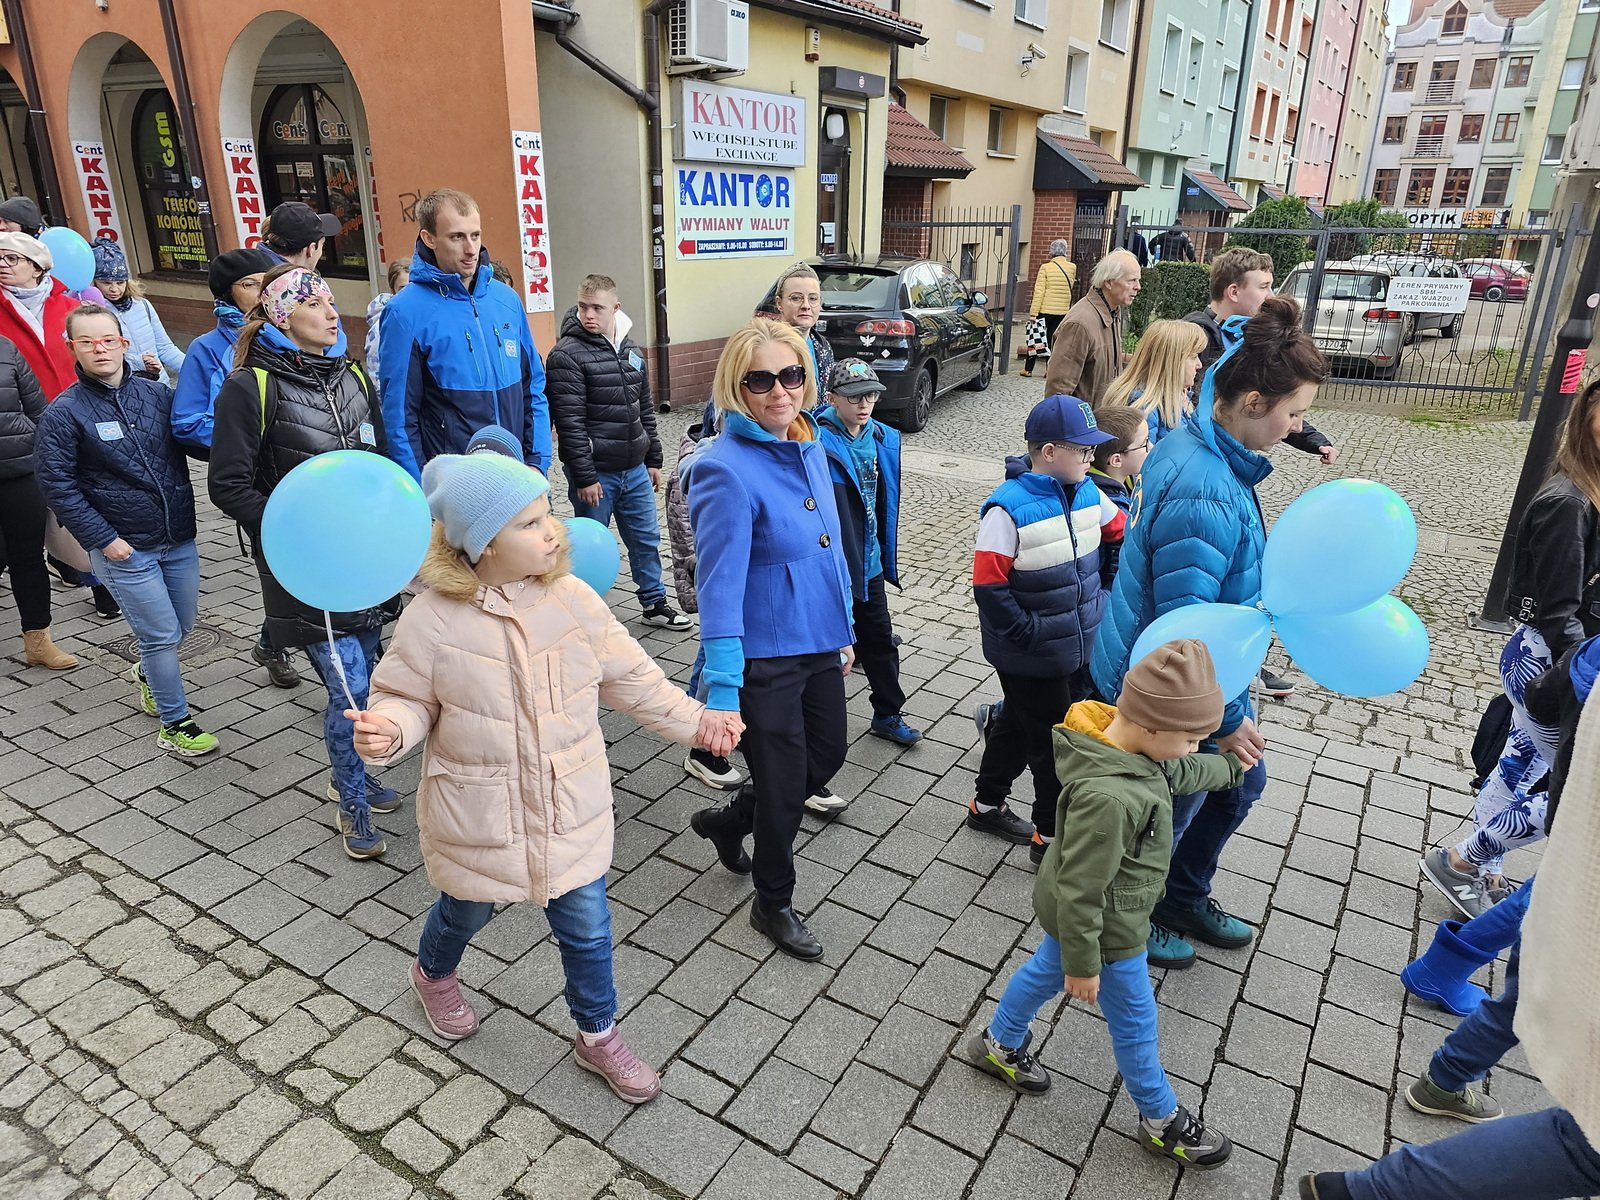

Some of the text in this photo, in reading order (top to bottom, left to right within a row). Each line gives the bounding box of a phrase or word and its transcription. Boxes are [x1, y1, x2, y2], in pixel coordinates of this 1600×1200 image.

[690, 90, 797, 135] KANTOR
[273, 120, 305, 138] Cent
[224, 141, 253, 153] Cent
[514, 137, 541, 149] Cent
[692, 130, 798, 150] WECHSELSTUBE
[75, 145, 103, 155] Cent
[716, 147, 778, 162] EXCHANGE
[678, 169, 790, 208] KANTOR
[80, 157, 119, 242] KANTO
[163, 197, 197, 213] TELEFO
[230, 156, 263, 249] KANTO
[156, 214, 202, 230] KOMÓRK
[519, 154, 549, 294] KANTOR
[680, 217, 744, 232] WYMIANY
[750, 217, 790, 231] WALUT
[1408, 213, 1458, 224] OPTIK
[1401, 300, 1450, 308] PARKOWANIA
[1452, 884, 1477, 901] N
